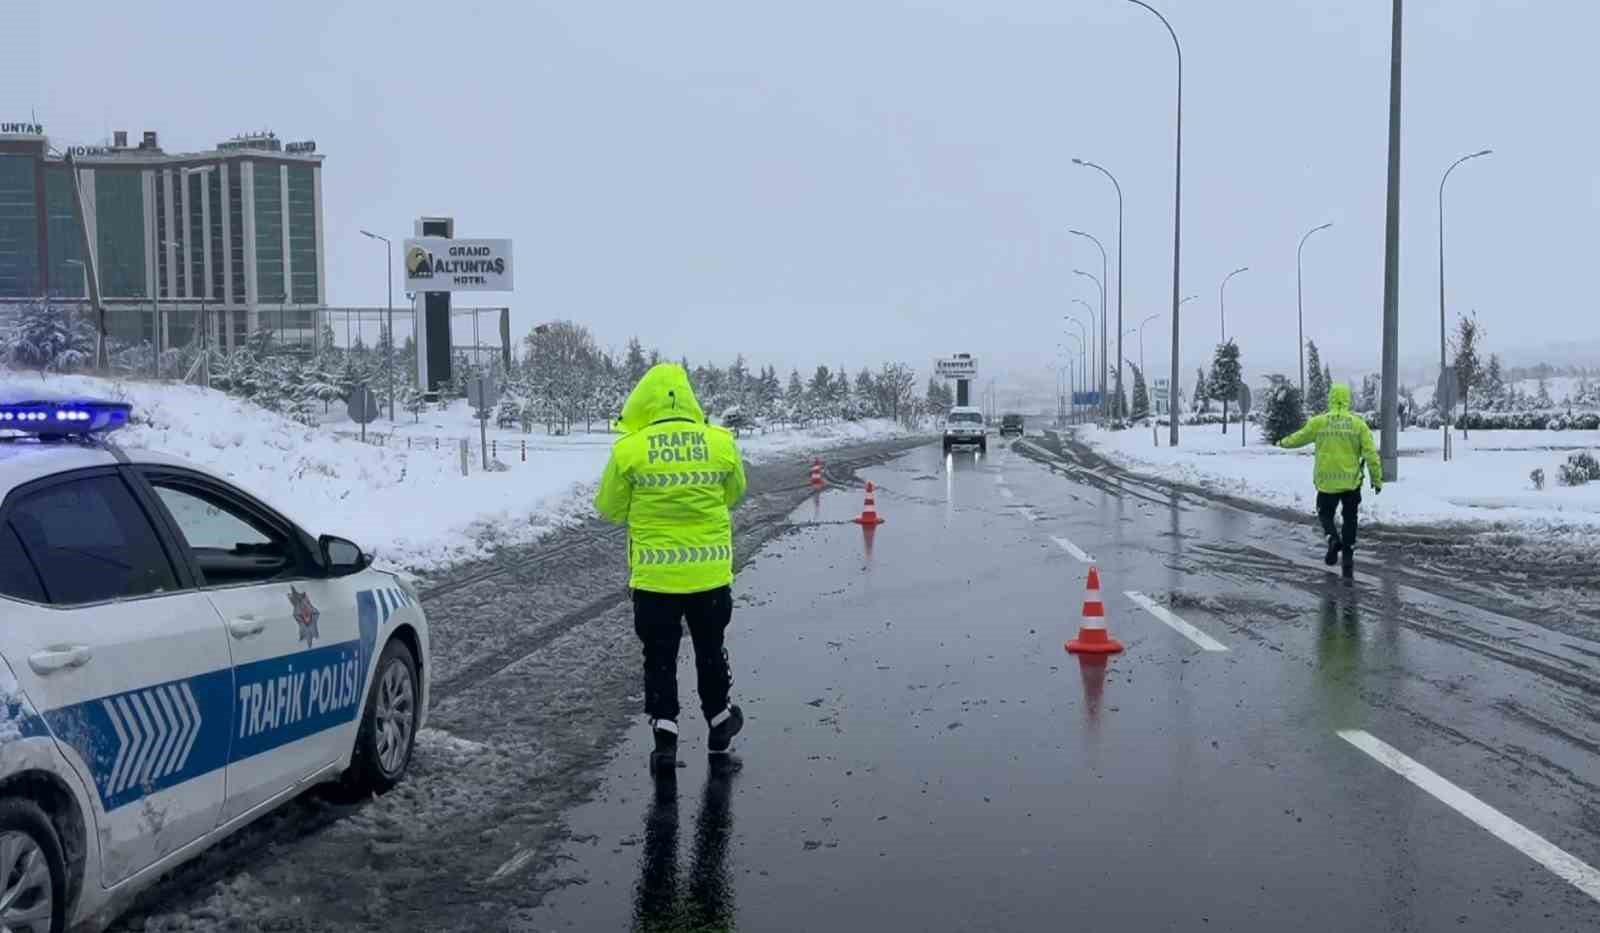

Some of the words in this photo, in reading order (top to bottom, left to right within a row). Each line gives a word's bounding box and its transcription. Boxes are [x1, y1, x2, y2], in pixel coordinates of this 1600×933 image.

[449, 247, 490, 256] GRAND
[435, 258, 504, 274] ALTUNTAŞ
[454, 276, 487, 284] HOTEL
[240, 664, 305, 738] TRAFİK
[307, 650, 359, 718] POLİSİ
